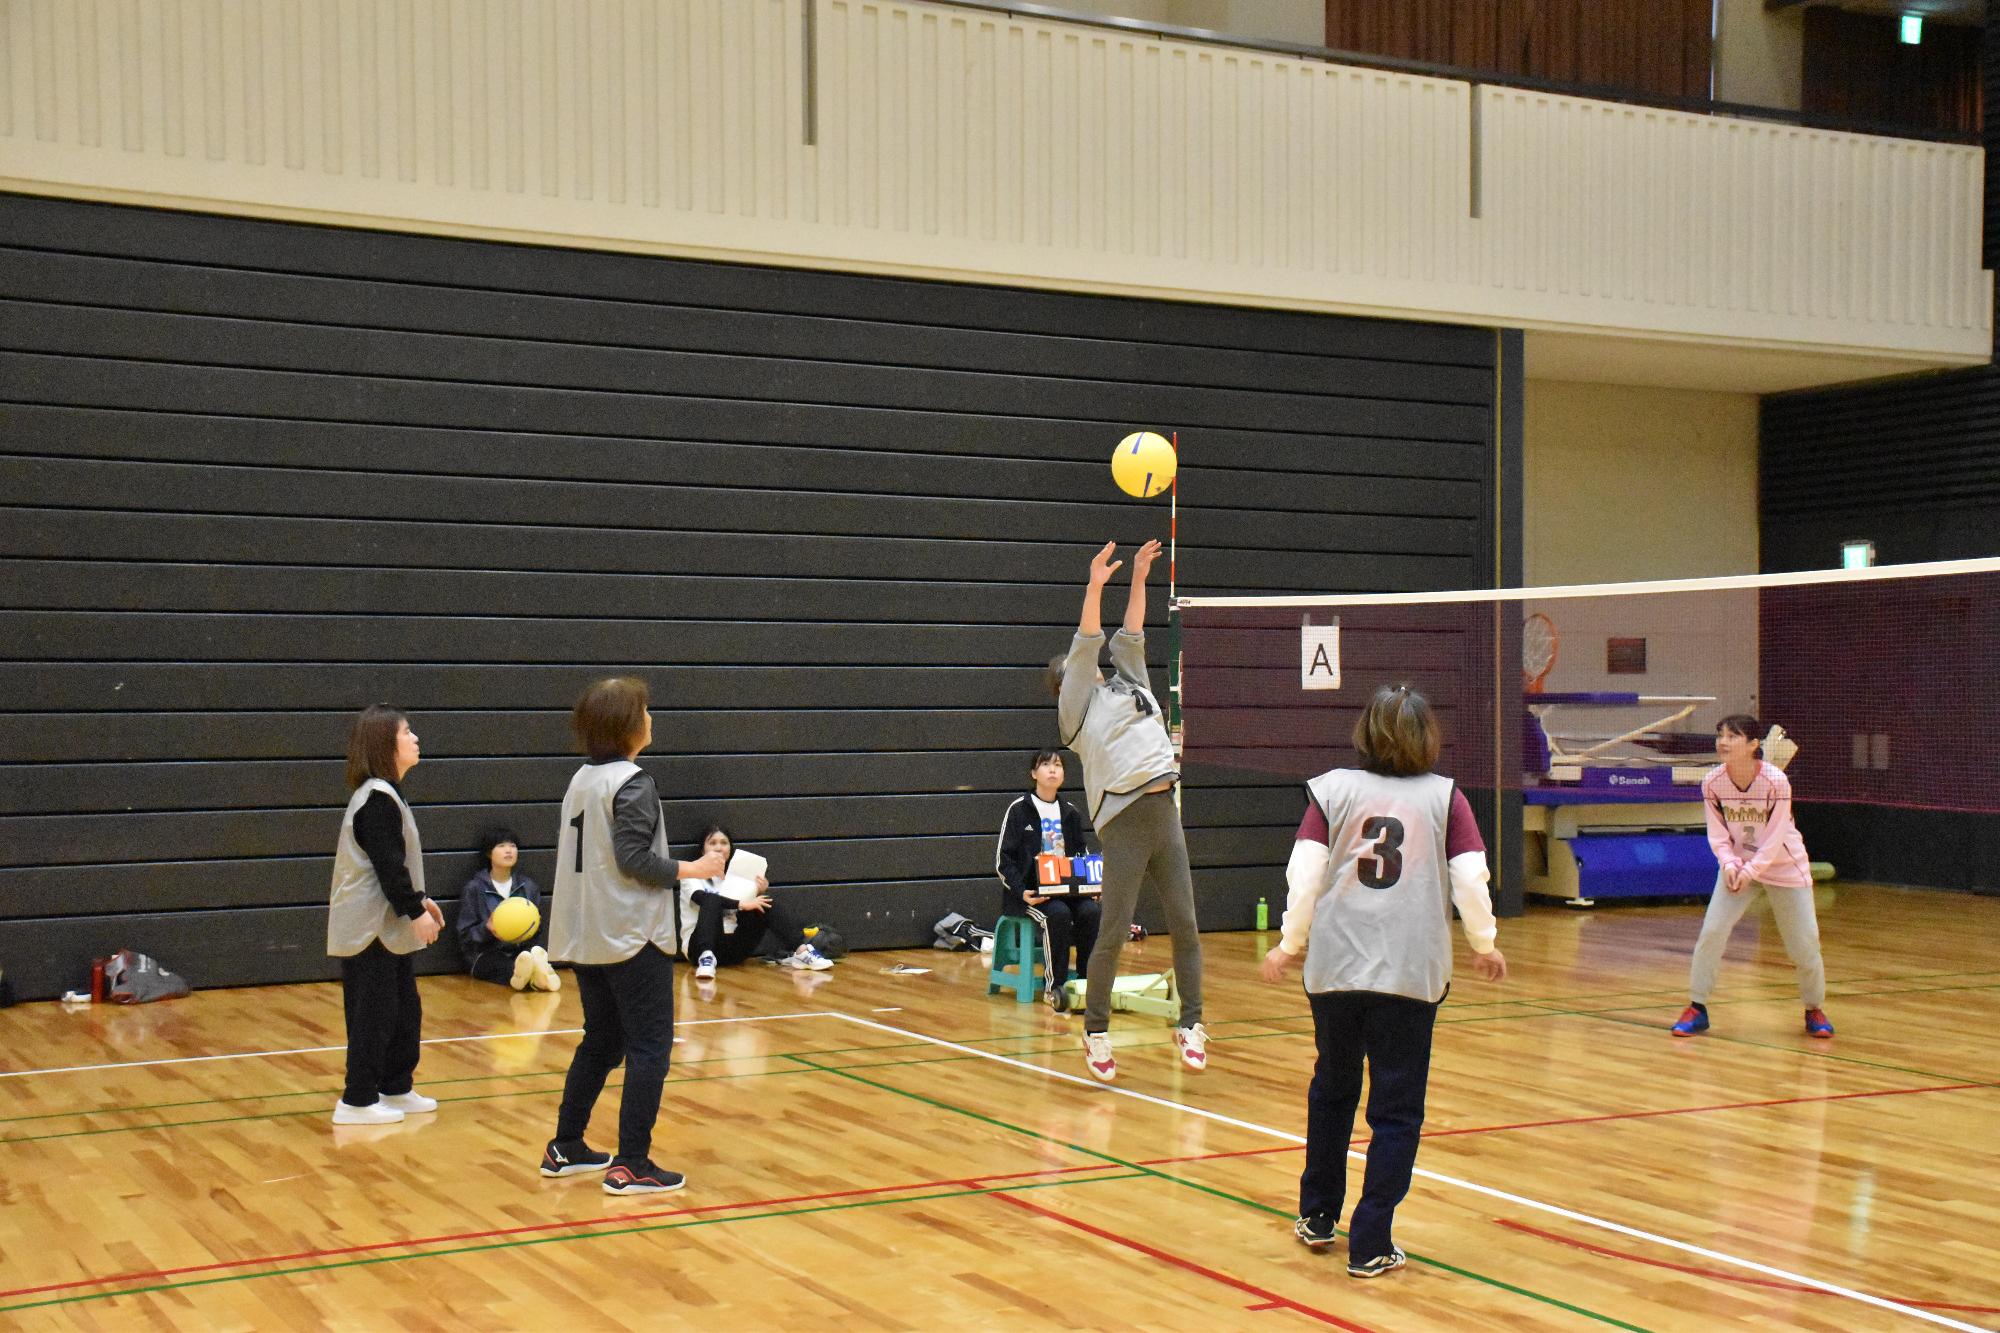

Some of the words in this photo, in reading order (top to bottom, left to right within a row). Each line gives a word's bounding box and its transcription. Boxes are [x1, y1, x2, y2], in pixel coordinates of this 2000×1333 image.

[1309, 643, 1334, 676] A
[570, 809, 585, 873] 1
[1357, 816, 1405, 889] 3
[1044, 860, 1056, 882] 1
[1086, 860, 1103, 882] 10
